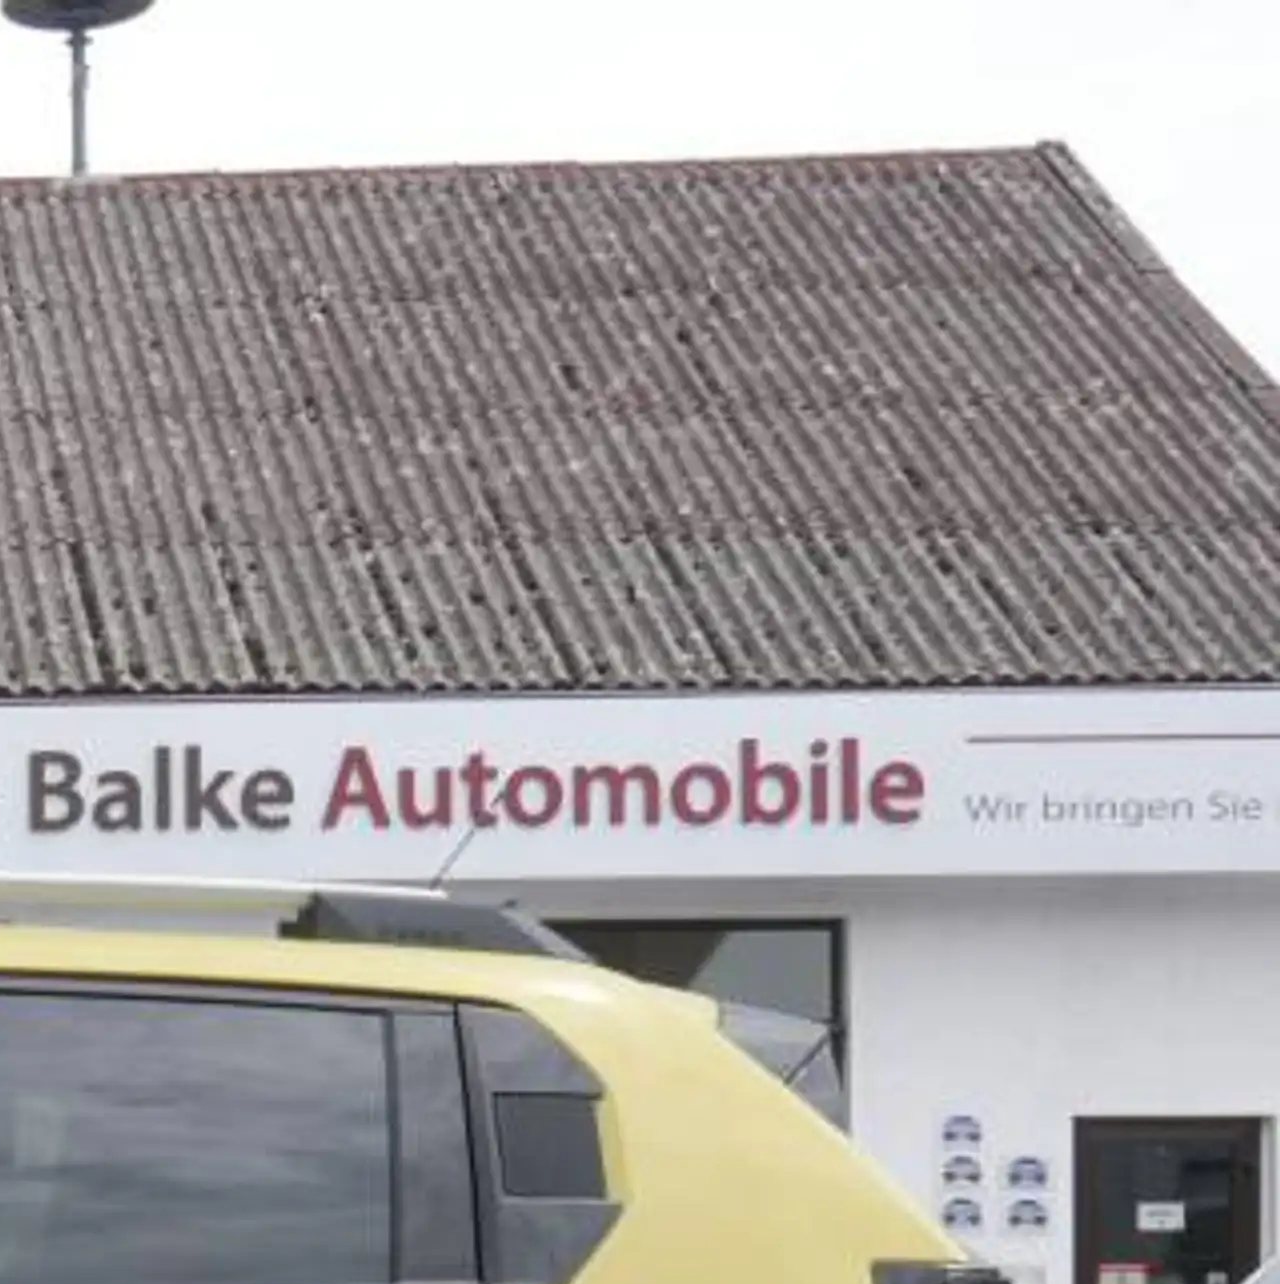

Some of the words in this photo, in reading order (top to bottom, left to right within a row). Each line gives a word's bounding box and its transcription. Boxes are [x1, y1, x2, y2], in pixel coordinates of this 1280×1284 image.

[28, 744, 295, 834] Balke
[321, 738, 925, 829] Automobile
[963, 793, 1027, 823] Wir
[1041, 790, 1194, 828] bringen
[1206, 790, 1264, 822] Sie
